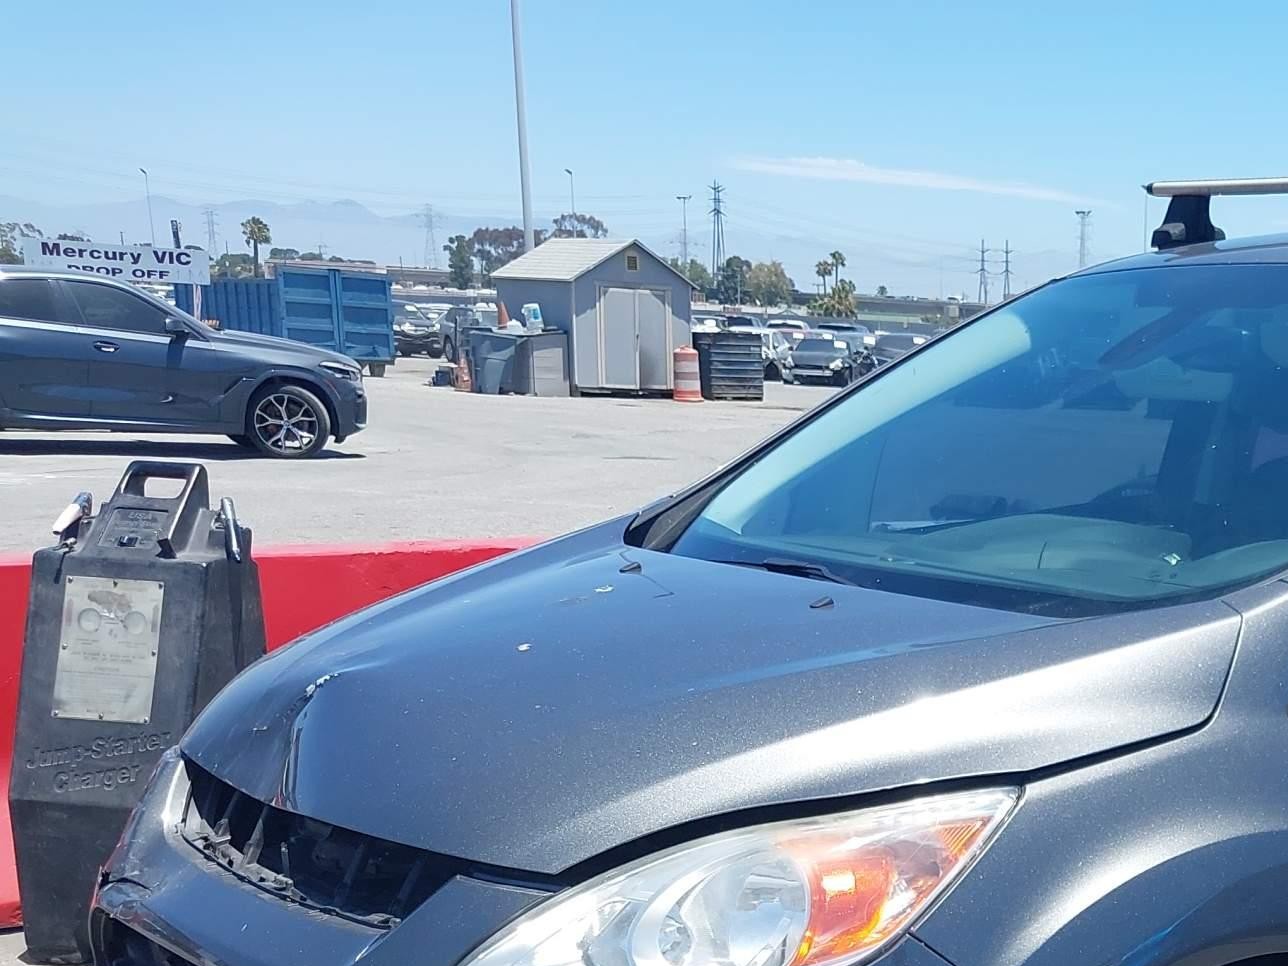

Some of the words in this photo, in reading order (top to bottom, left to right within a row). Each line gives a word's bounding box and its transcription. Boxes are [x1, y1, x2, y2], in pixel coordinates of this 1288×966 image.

[41, 241, 142, 264] Mercury
[153, 249, 192, 266] VIC
[131, 268, 170, 280] OFF
[26, 730, 172, 770] Jump-Starter
[53, 764, 141, 793] Charger
